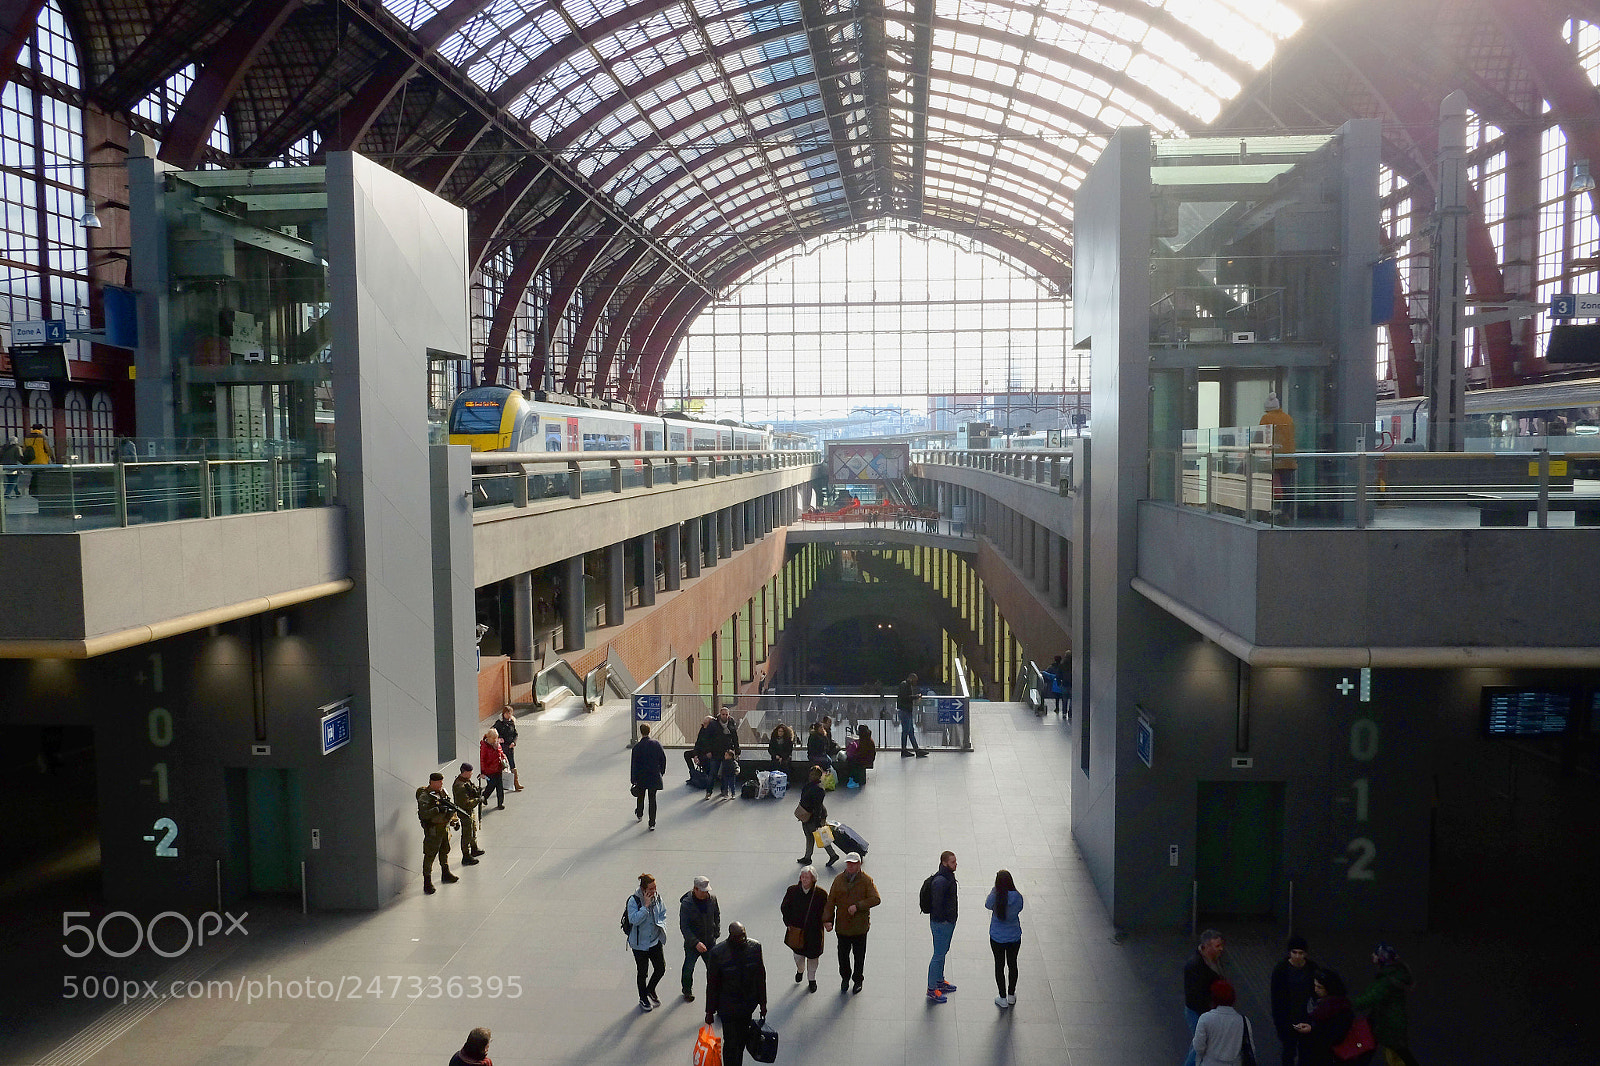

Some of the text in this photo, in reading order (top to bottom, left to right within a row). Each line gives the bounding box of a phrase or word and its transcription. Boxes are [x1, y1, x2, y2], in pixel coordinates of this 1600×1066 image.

[1558, 301, 1568, 314] 3
[17, 328, 34, 336] Zone
[51, 326, 60, 338] 4
[148, 707, 174, 747] 0
[1350, 718, 1379, 762] 0
[140, 762, 170, 804] -1
[142, 817, 179, 858] -2
